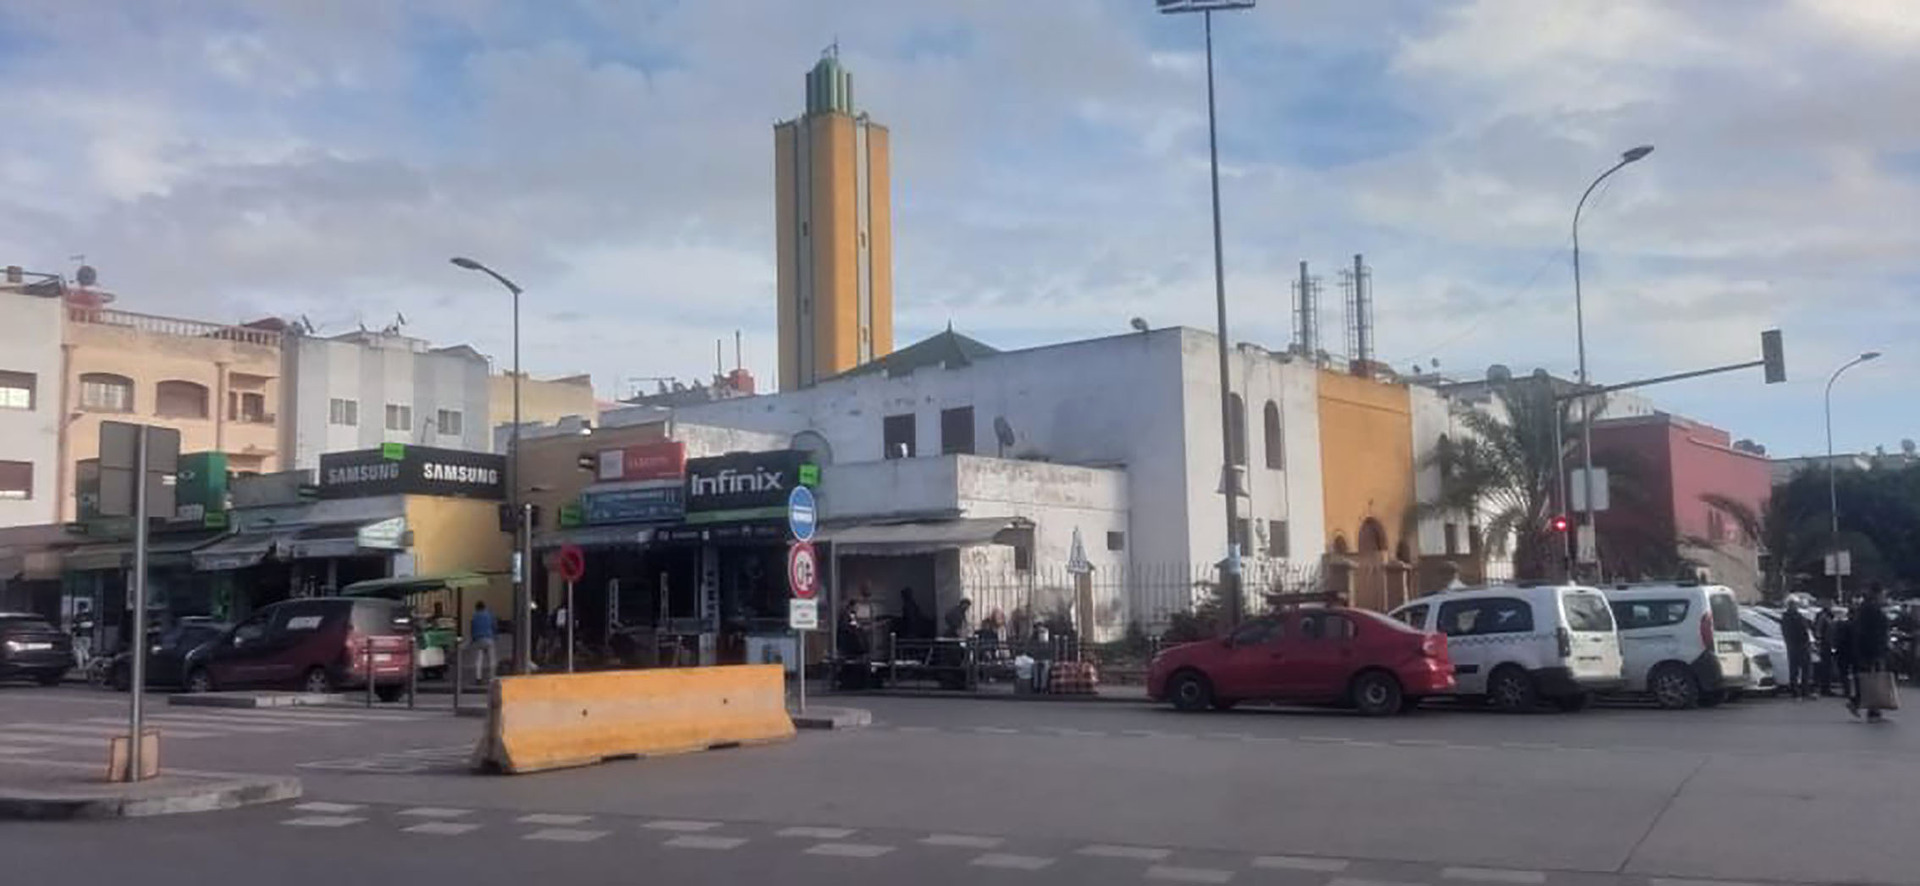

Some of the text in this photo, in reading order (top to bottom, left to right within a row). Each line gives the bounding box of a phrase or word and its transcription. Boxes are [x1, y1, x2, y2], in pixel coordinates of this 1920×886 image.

[328, 463, 399, 484] SAMSUNG
[423, 463, 497, 484] SAMSUNG
[692, 466, 782, 495] Infinix
